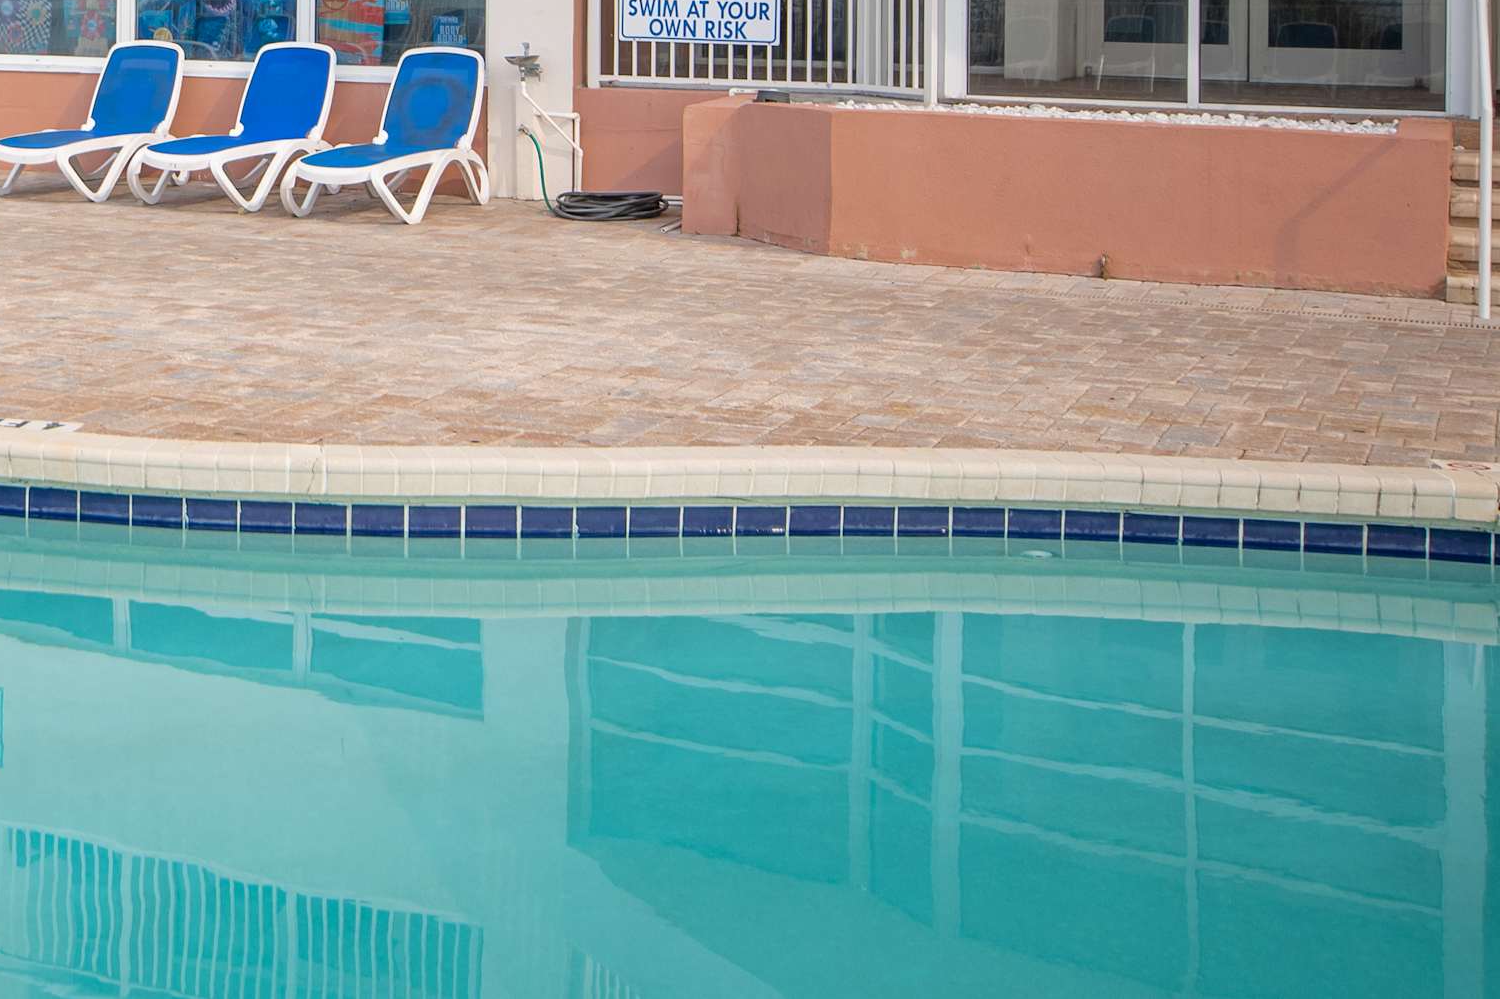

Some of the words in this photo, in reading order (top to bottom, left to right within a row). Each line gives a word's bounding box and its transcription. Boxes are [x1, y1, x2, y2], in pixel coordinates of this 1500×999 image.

[686, 0, 709, 18] AT
[717, 1, 771, 20] YOUR
[649, 18, 696, 38] OWN
[705, 21, 747, 39] RISK
